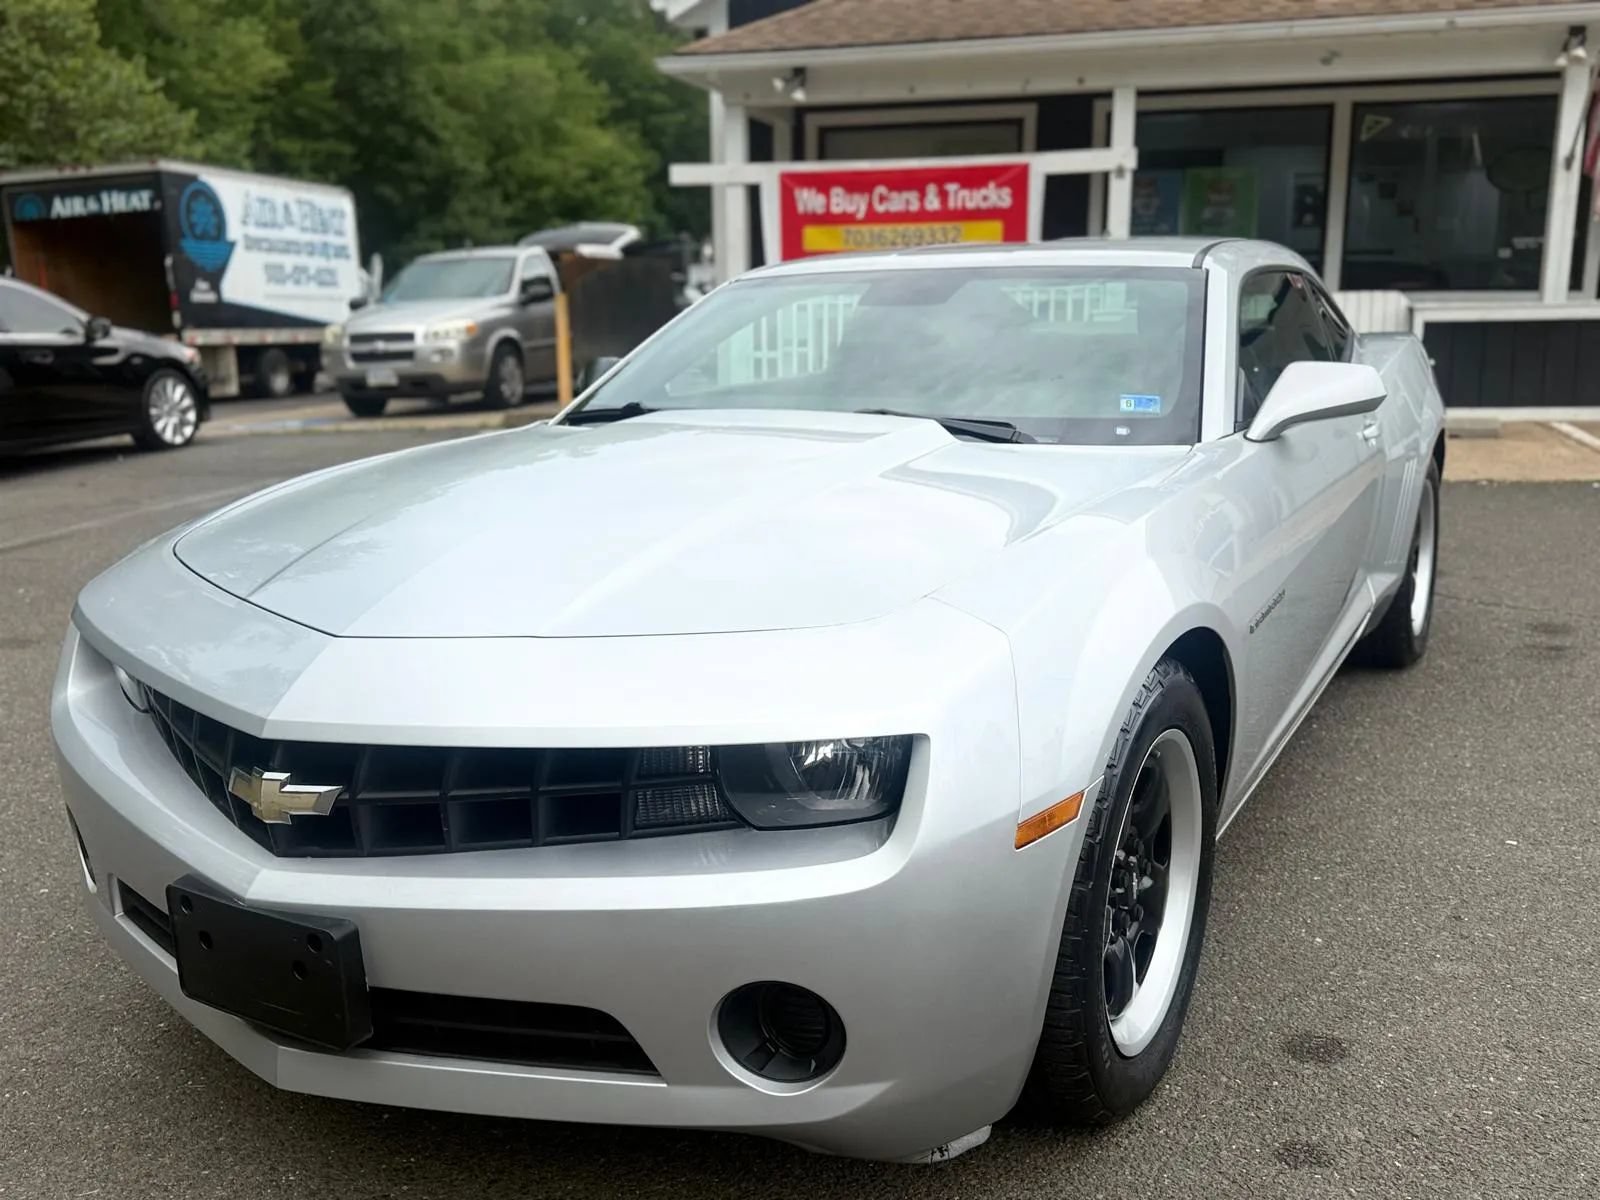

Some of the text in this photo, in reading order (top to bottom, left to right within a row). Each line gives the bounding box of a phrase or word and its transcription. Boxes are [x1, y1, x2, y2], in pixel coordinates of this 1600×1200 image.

[50, 194, 86, 218] AIR
[100, 189, 153, 213] HEAT
[795, 182, 1012, 220] We Buy Cars & Trucks
